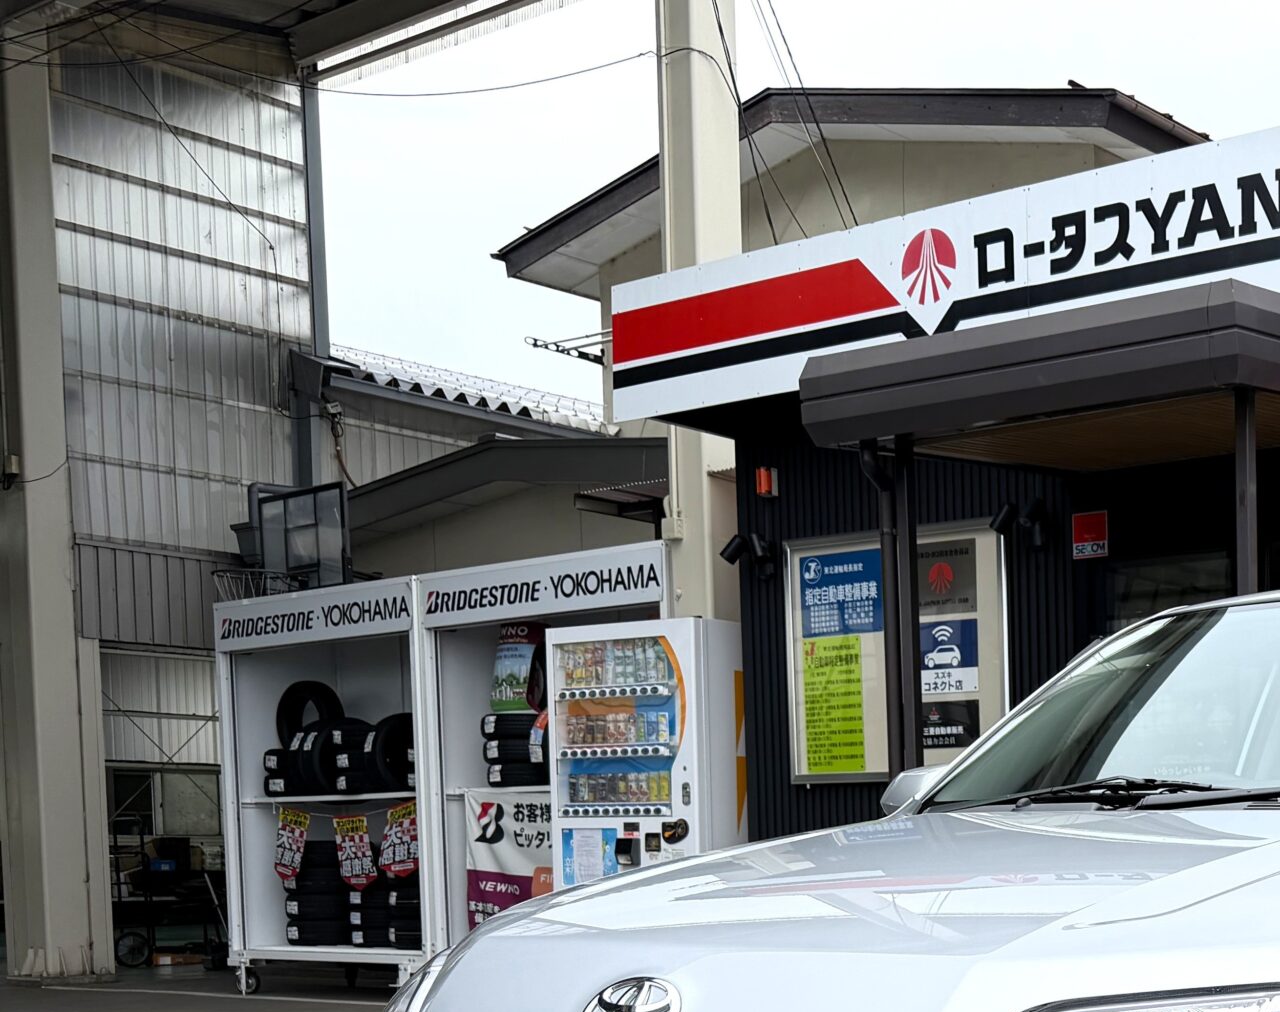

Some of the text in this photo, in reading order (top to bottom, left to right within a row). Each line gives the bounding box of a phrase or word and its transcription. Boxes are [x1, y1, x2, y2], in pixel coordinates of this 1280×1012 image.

[1074, 542, 1106, 555] SECOM
[426, 563, 660, 615] BRIDGESTONE YOKOHAMA
[220, 595, 411, 640] BRIDGESTONE YOKOHAMA
[934, 671, 953, 680] スズキ
[923, 680, 963, 692] コネクト店
[513, 802, 551, 823] お客様
